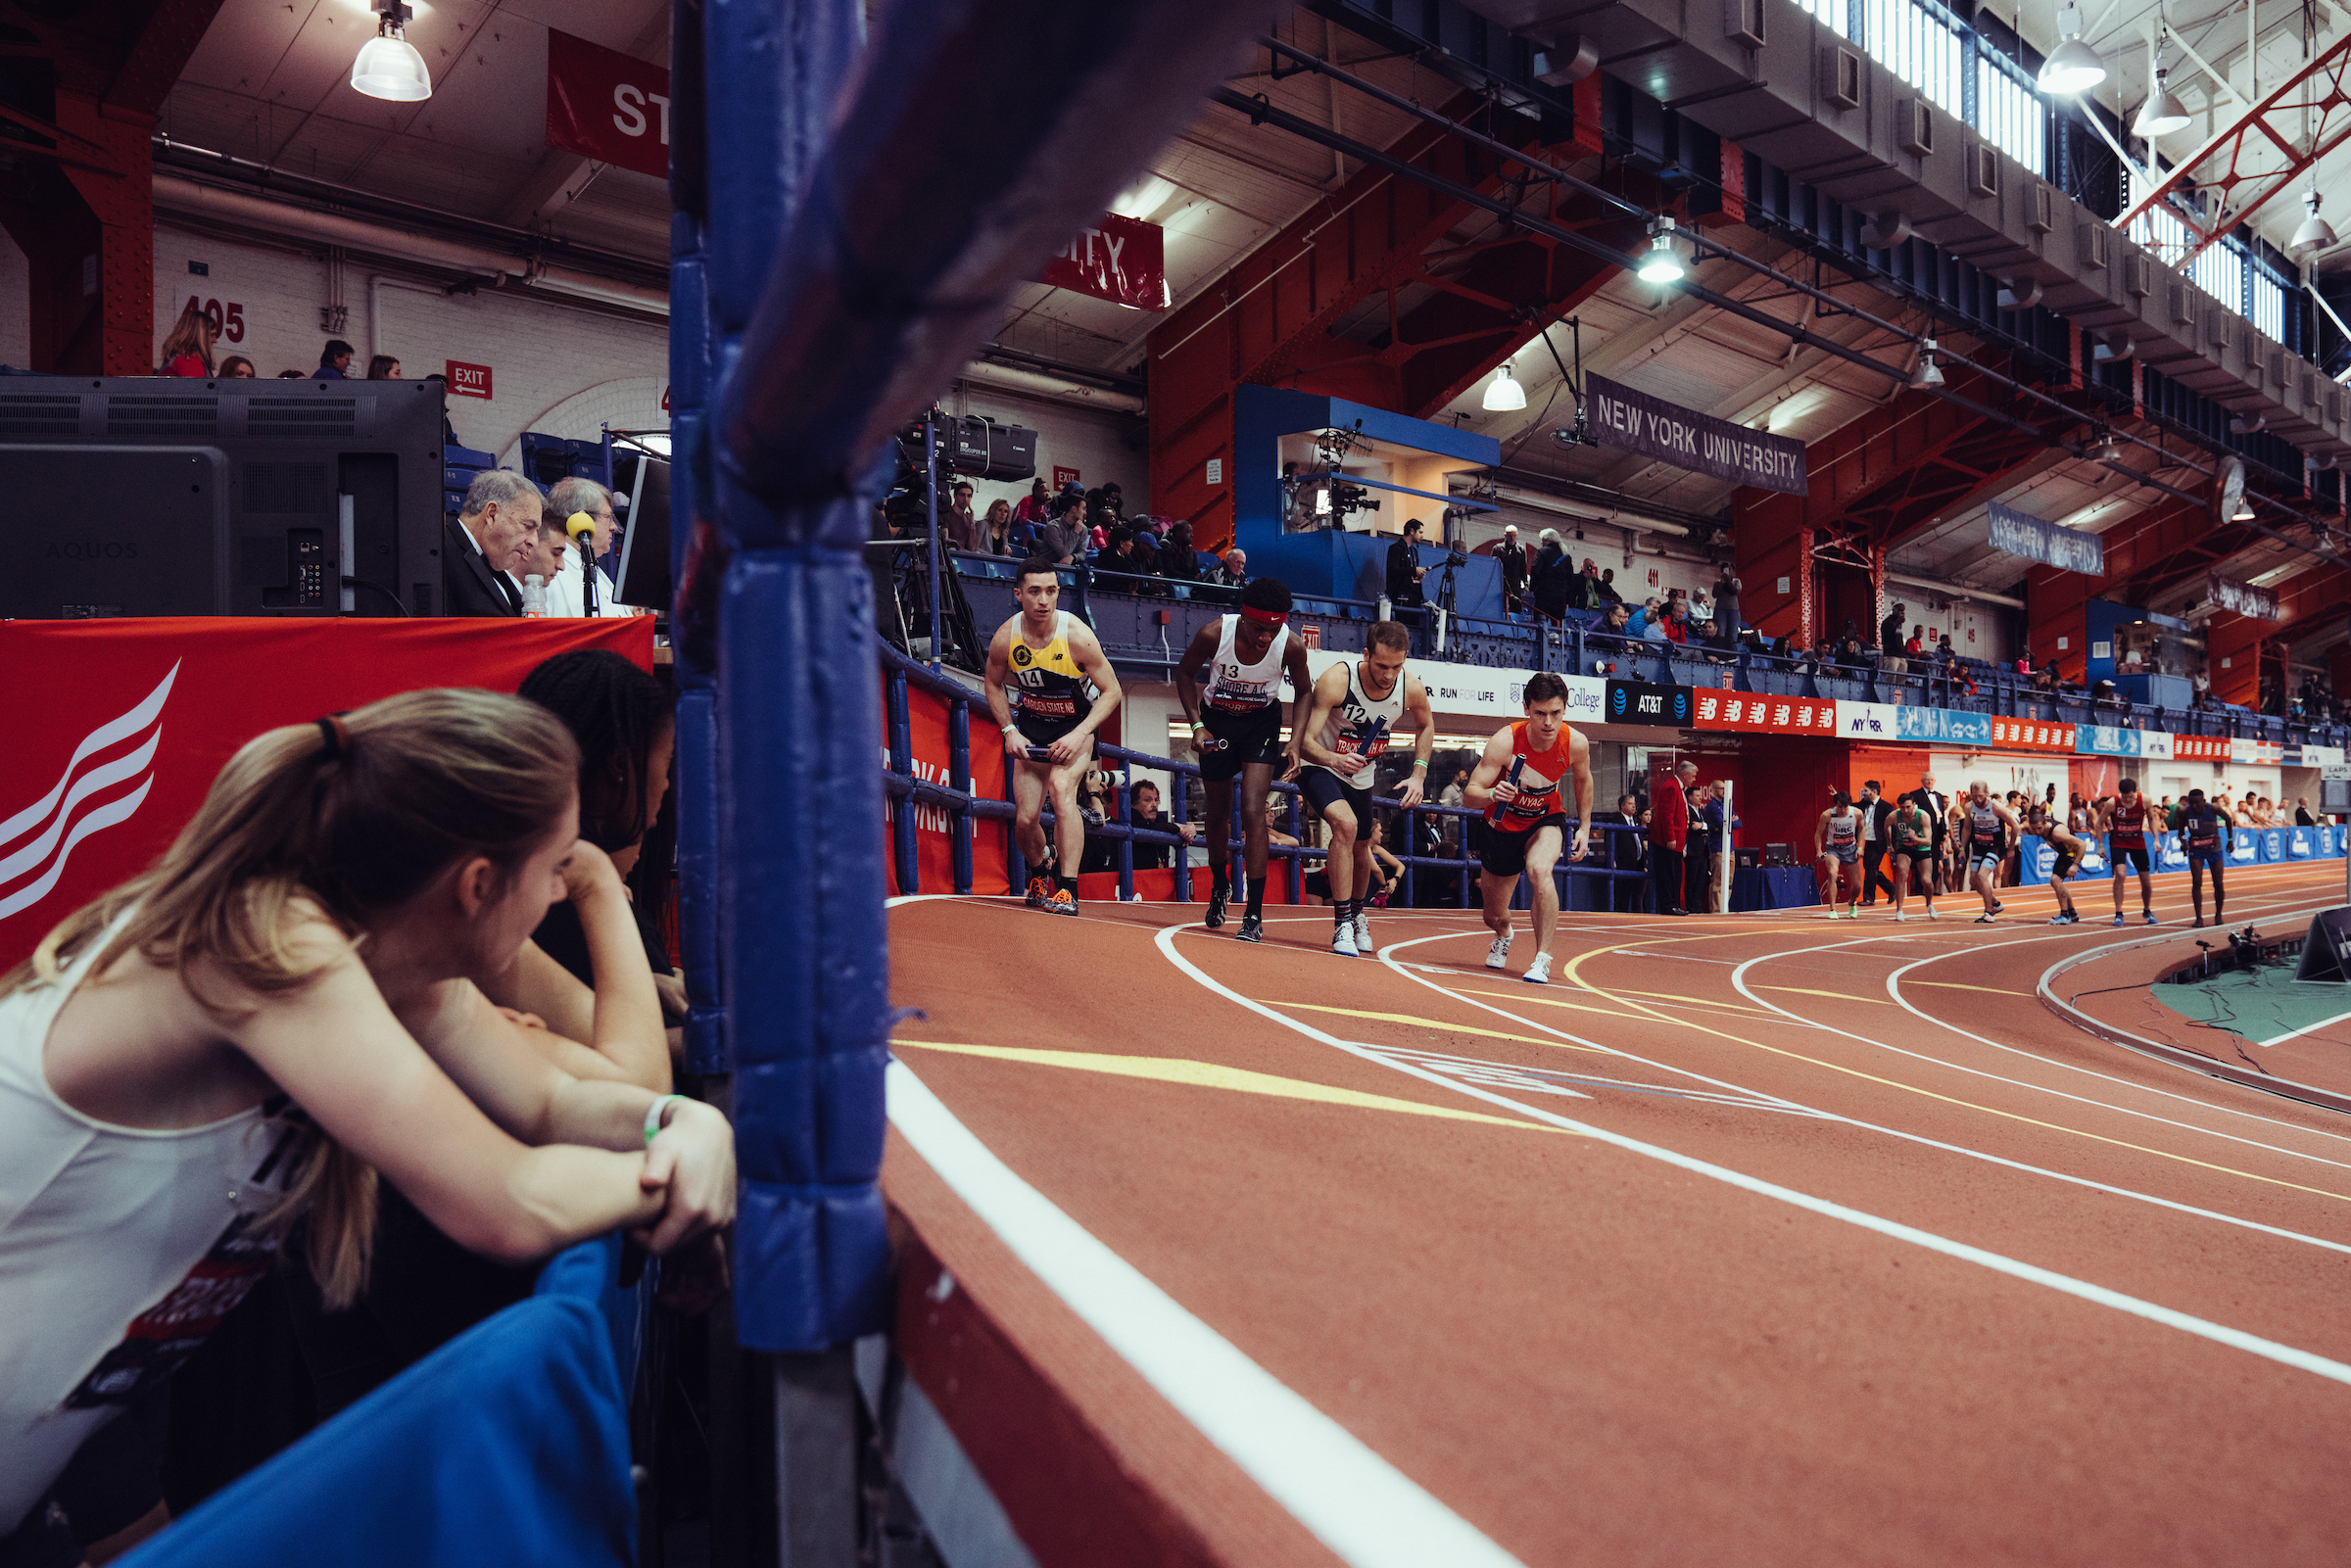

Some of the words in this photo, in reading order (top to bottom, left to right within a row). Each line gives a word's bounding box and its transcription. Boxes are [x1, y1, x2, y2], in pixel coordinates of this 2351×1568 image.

[455, 367, 484, 385] EXIT
[1598, 394, 1643, 437] NEW
[1647, 412, 1697, 455] YORK
[1703, 431, 1797, 479] UNIVERSITY
[1058, 471, 1076, 483] EXIT
[46, 542, 138, 561] AQUOS
[1648, 568, 1658, 588] 411
[1303, 633, 1319, 649] EXIT
[1020, 671, 1039, 686] 14
[1220, 664, 1239, 678] 13
[1216, 676, 1249, 694] SHORE
[1440, 688, 1457, 699] RUN
[1460, 689, 1476, 700] FOR
[1478, 691, 1494, 702] LIFE
[1566, 688, 1600, 713] College
[1023, 697, 1047, 711] GARDEN
[1047, 700, 1065, 713] STATE
[1065, 702, 1075, 713] NB
[1638, 694, 1663, 714] AT&T
[1347, 706, 1366, 722] 12
[1519, 796, 1544, 807] NYAC
